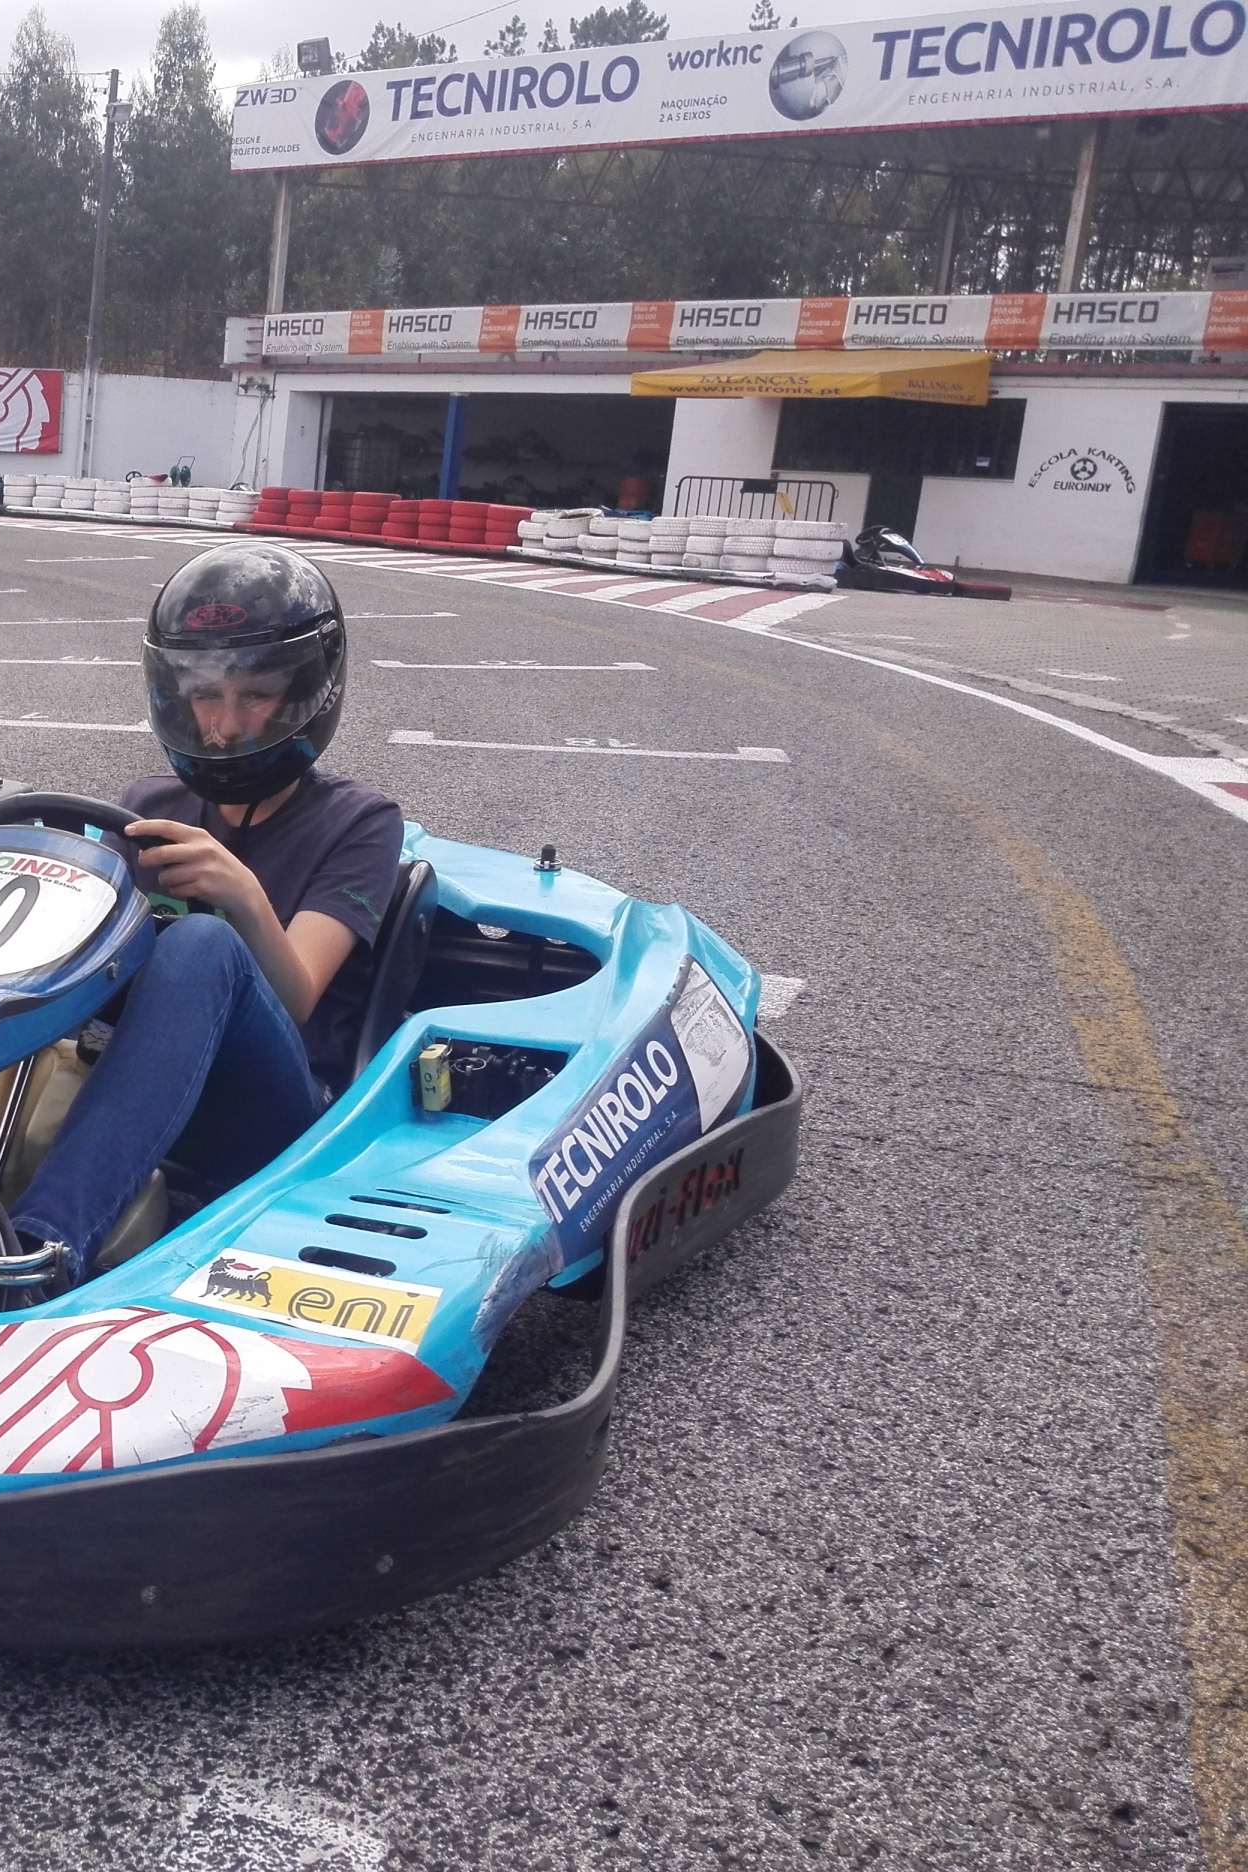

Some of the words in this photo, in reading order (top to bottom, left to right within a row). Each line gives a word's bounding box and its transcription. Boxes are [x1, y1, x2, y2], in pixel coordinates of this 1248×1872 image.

[872, 0, 1247, 81] TECNIROLO
[386, 55, 640, 121] TECNIROLO
[908, 87, 1014, 106] ENGENHARIA
[1144, 77, 1180, 91] S.A.
[660, 94, 728, 109] MAQUINAÇÃO
[683, 110, 711, 121] EIXOS
[410, 127, 485, 143] ENGENHARIA
[524, 311, 597, 330] HASCO
[679, 307, 762, 328] HASCO
[853, 304, 948, 325] HASCO
[1053, 301, 1160, 324] HASCO
[267, 318, 325, 337] HASCO
[388, 314, 452, 333] HASCO
[676, 335, 719, 346] Enabling
[852, 333, 900, 345] Enabling
[1049, 333, 1105, 345] Enabling
[1109, 333, 1136, 345] with
[1027, 448, 1078, 488] ESCOLA
[1087, 447, 1136, 494] KARTING
[1053, 480, 1112, 493] EUROINDY
[536, 1039, 678, 1224] TECNIROLO
[579, 1175, 624, 1232] ENGENHARIA
[287, 1287, 421, 1339] eni
